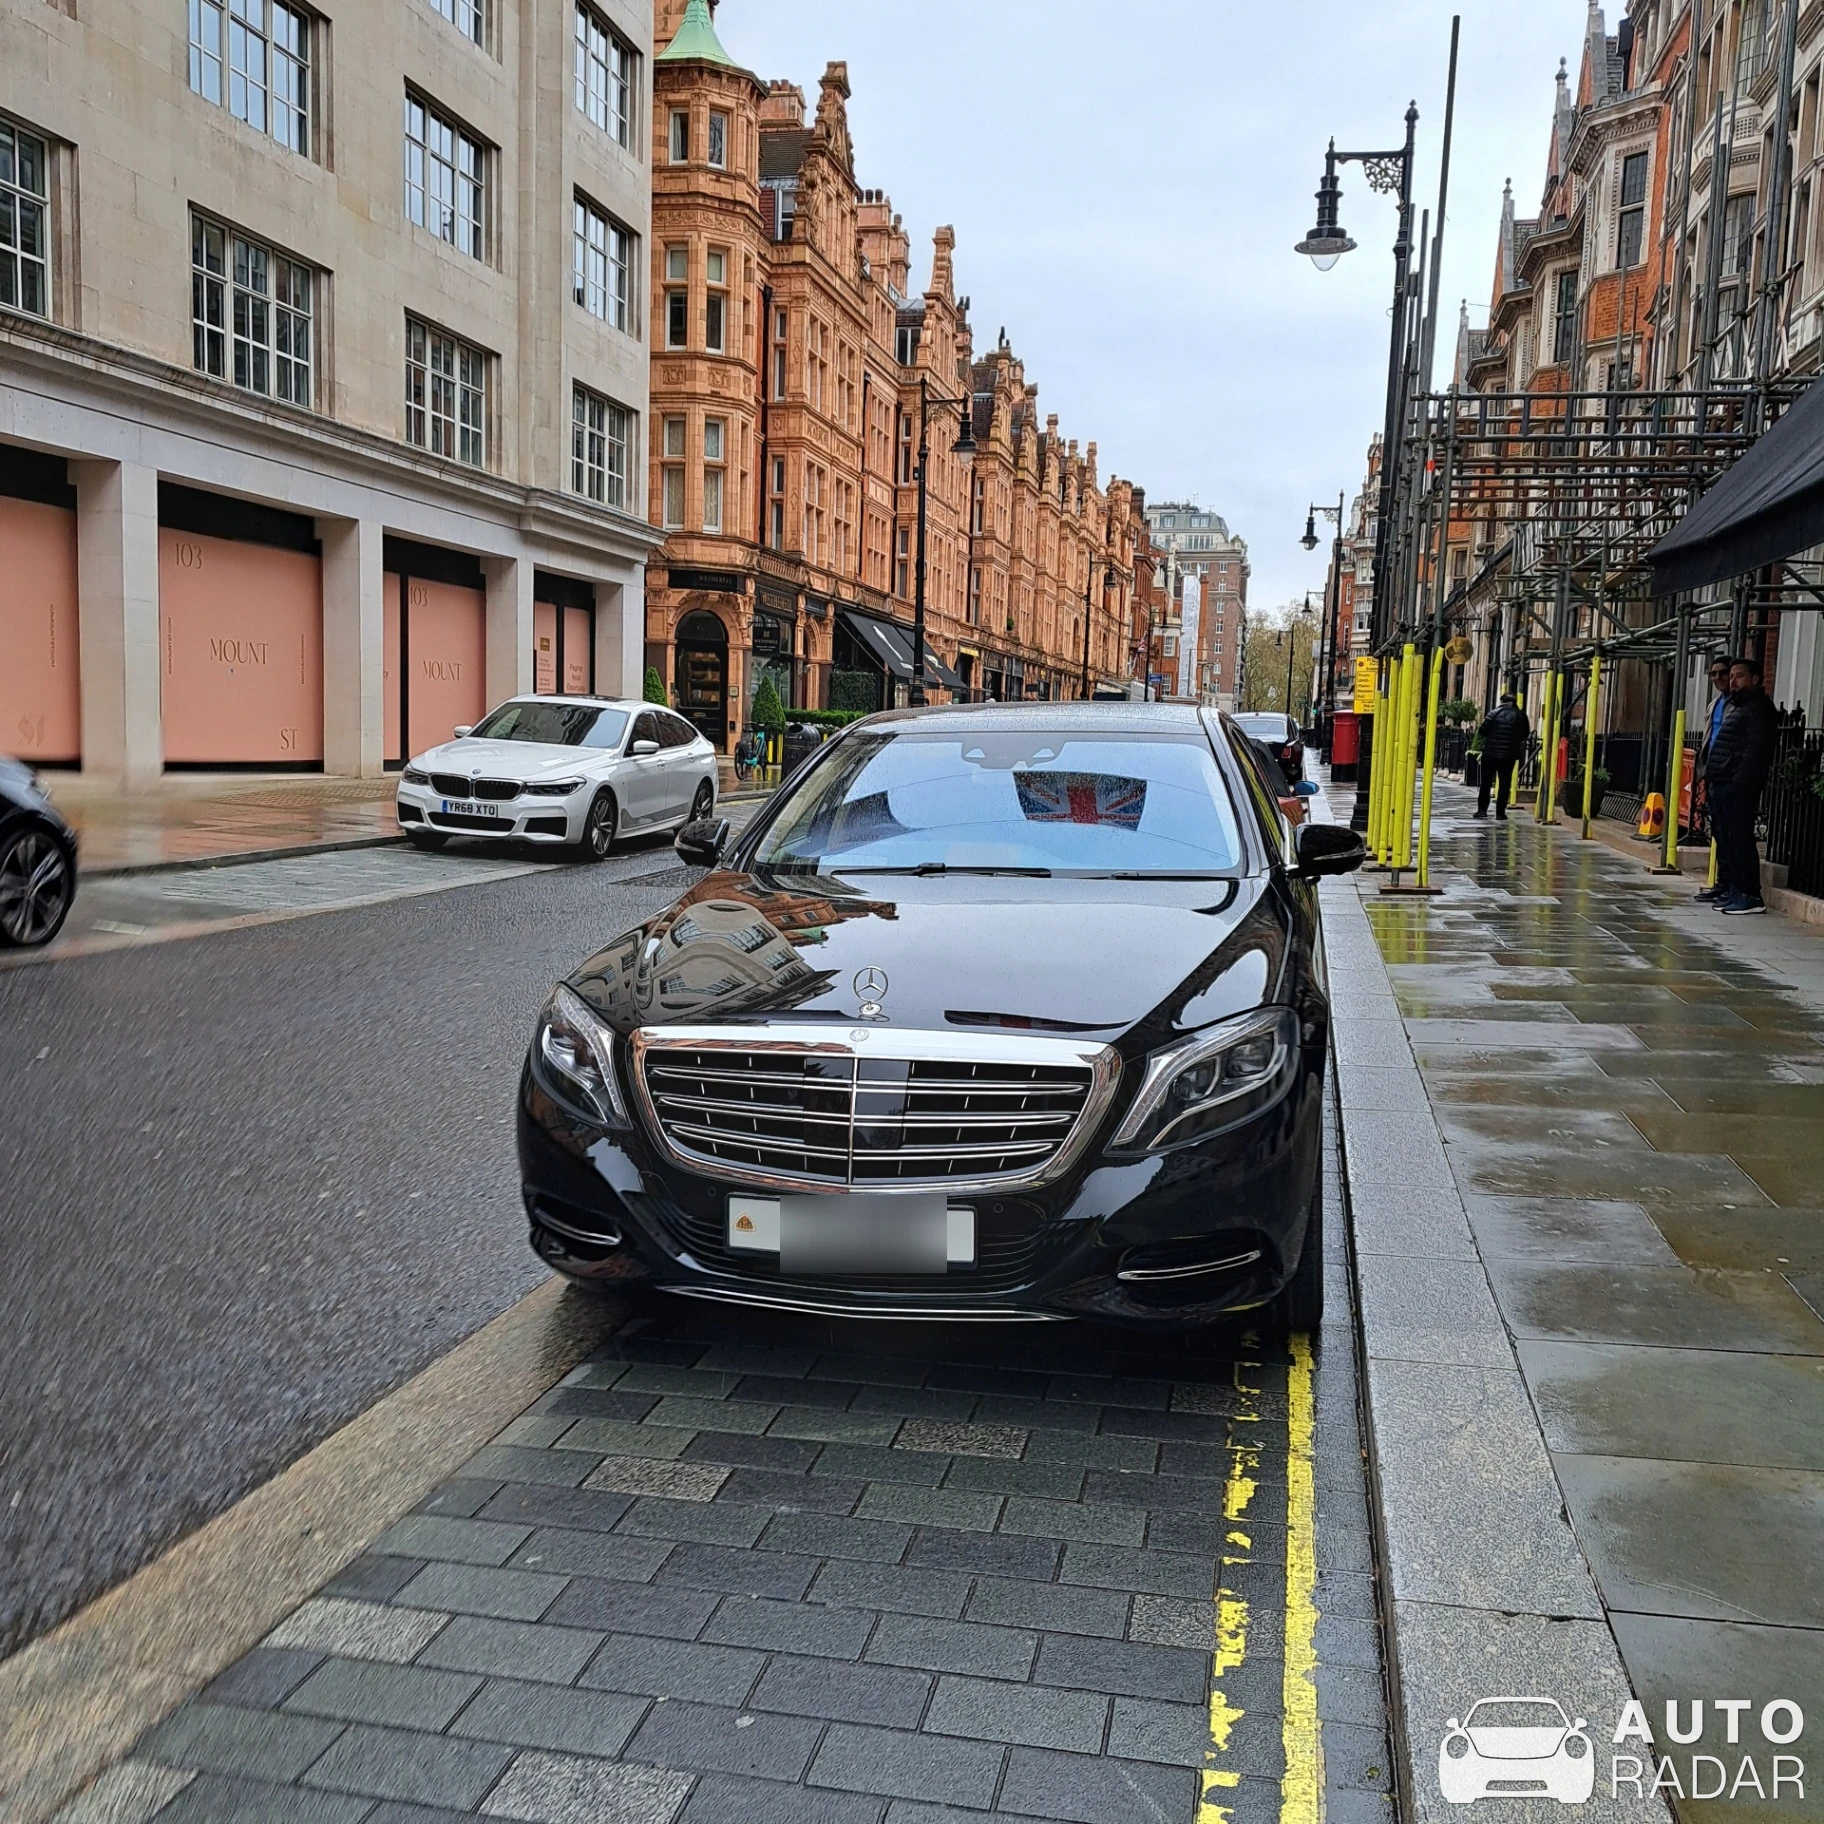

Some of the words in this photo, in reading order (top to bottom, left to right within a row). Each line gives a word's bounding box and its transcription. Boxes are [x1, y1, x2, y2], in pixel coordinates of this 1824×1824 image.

[176, 542, 202, 569] 103
[410, 586, 428, 607] 103
[210, 638, 269, 665] MOUNT
[422, 660, 462, 682] MOUNT
[280, 728, 299, 751] ST
[449, 801, 473, 813] YR68
[476, 804, 495, 816] XTO
